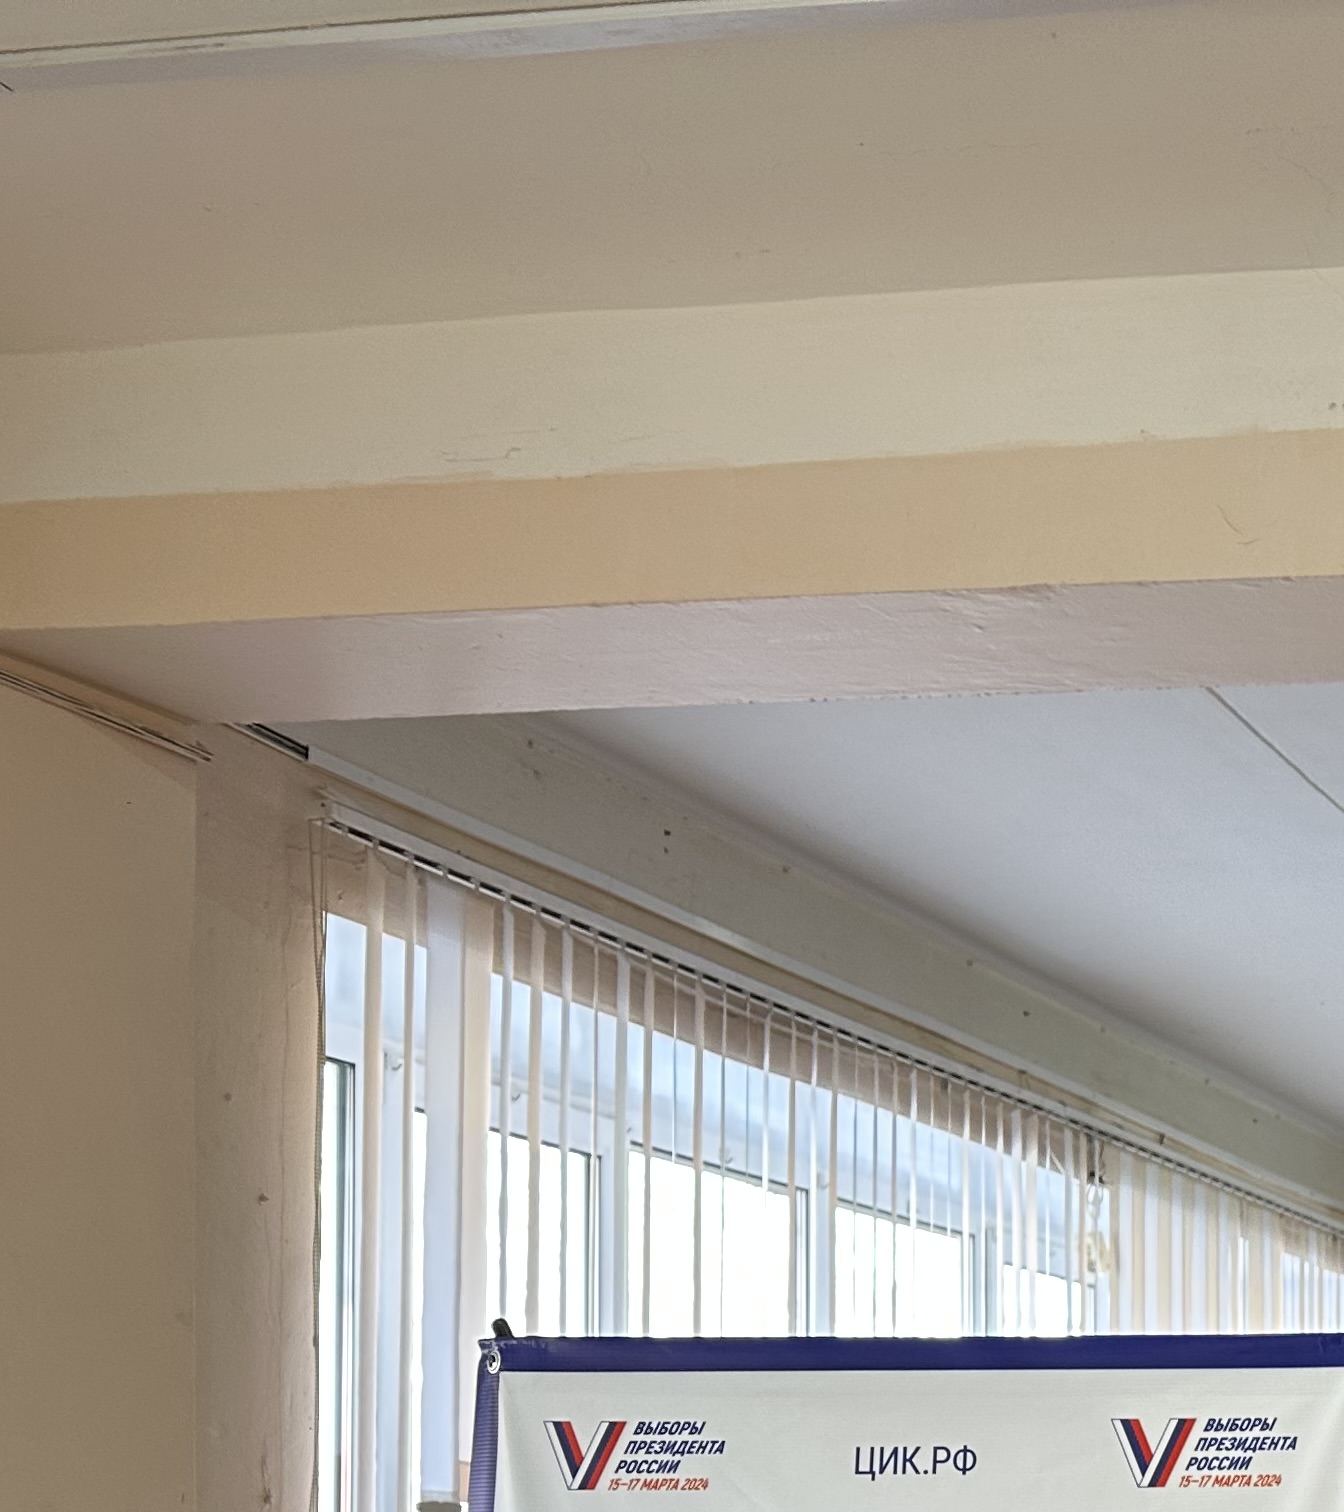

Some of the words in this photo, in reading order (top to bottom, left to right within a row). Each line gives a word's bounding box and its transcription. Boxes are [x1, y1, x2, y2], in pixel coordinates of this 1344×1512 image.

[633, 1421, 707, 1436] ВЫБОРЫ
[1203, 1417, 1278, 1433] ВЫБОРЫ
[623, 1440, 726, 1457] ПРЕЗИДЕНТА
[1193, 1436, 1298, 1453] ПРЕЗИДЕНТА
[614, 1459, 682, 1475] РОССИИ
[854, 1445, 978, 1482] ЦИК.РФ
[1184, 1456, 1254, 1472] РОССИИ
[640, 1478, 680, 1491] МАРТА
[680, 1477, 710, 1491] 2024
[1212, 1474, 1251, 1488] МАРТА
[1253, 1474, 1283, 1488] 2024
